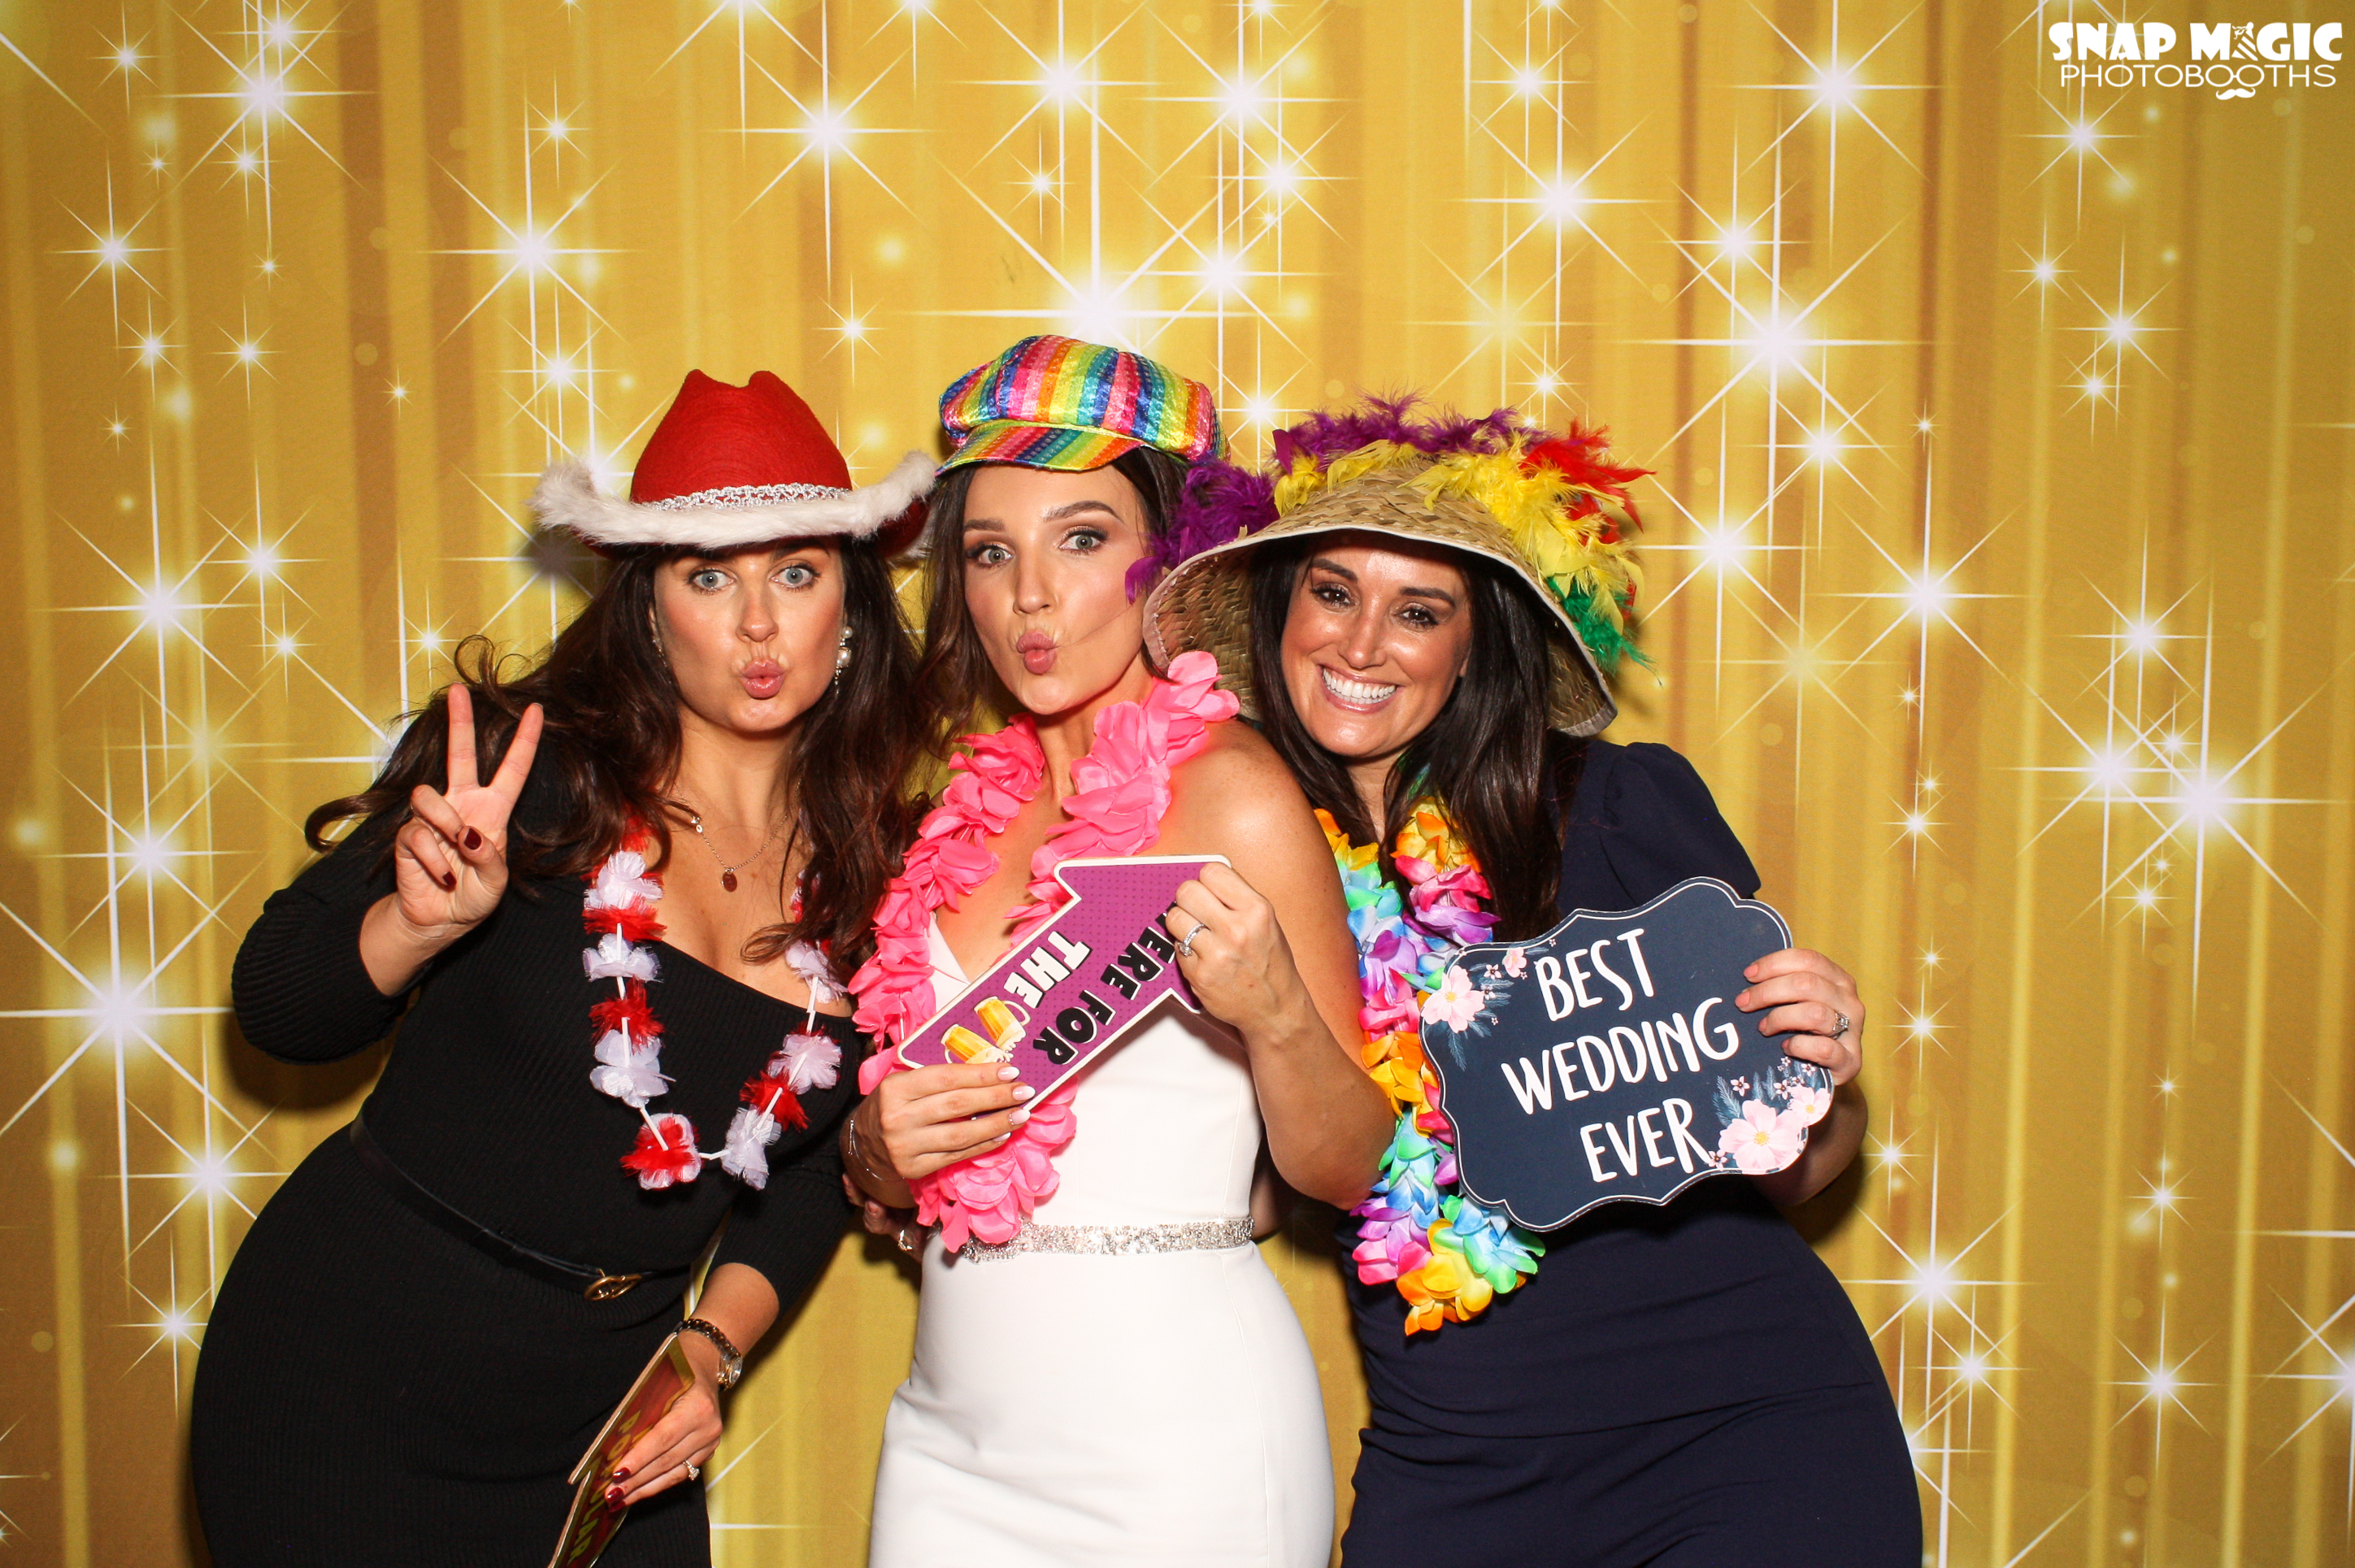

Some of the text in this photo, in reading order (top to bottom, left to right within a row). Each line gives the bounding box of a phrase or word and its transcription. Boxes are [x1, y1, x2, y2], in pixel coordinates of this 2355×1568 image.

[1003, 931, 1093, 1009] THE
[1032, 900, 1177, 1065] ERE FOR
[1535, 928, 1654, 1022] BEST
[1501, 997, 1740, 1115] WEDDING
[1579, 1097, 1712, 1183] EVER
